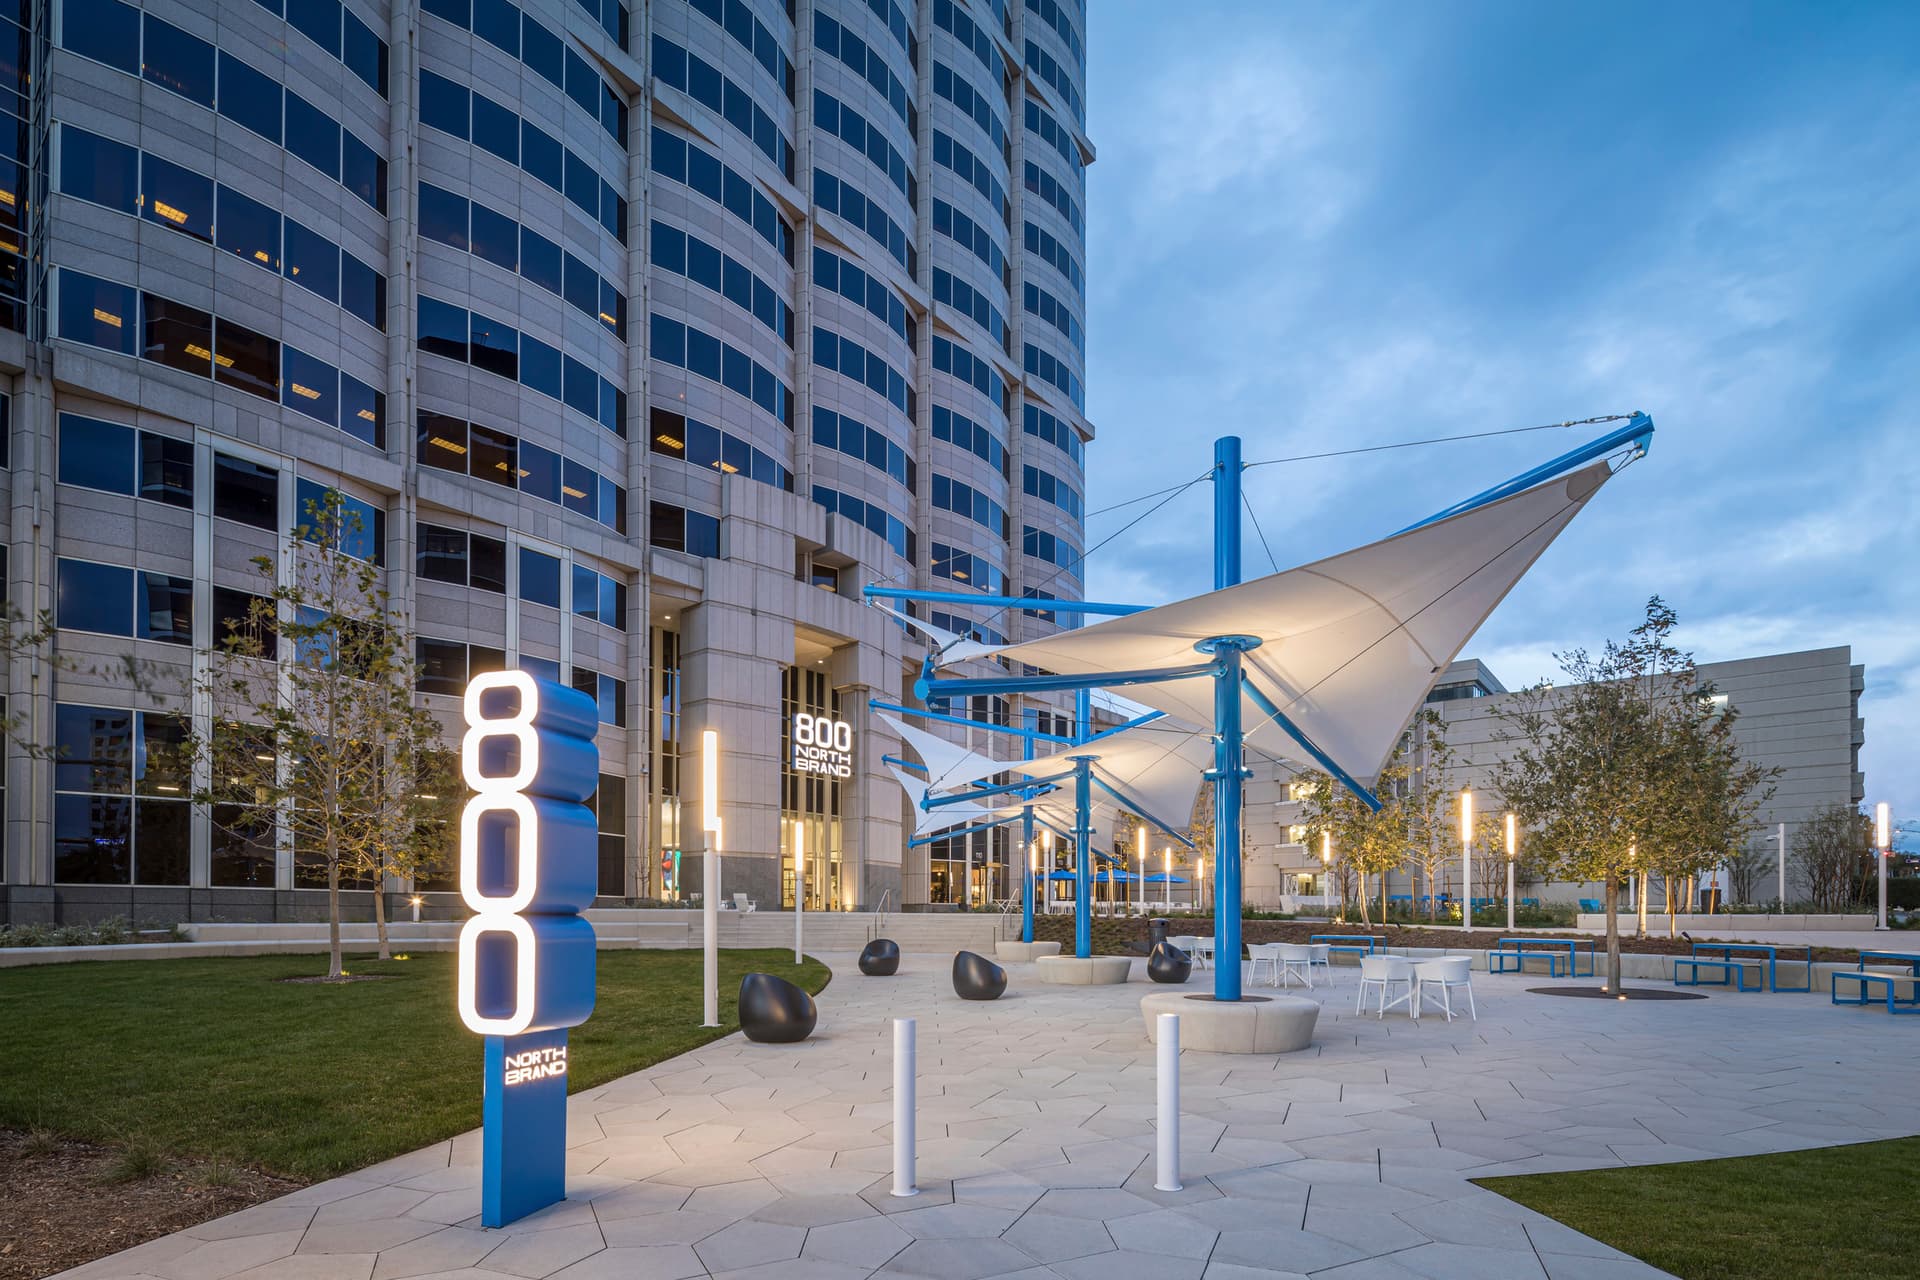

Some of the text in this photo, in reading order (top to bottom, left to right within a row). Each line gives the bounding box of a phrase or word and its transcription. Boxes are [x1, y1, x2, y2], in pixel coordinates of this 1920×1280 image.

[796, 713, 851, 752] 800
[796, 744, 851, 765] NORTH
[796, 758, 851, 778] BRAND
[458, 670, 538, 1036] 800
[505, 1046, 567, 1070] NORTH
[505, 1060, 567, 1085] BRAND
